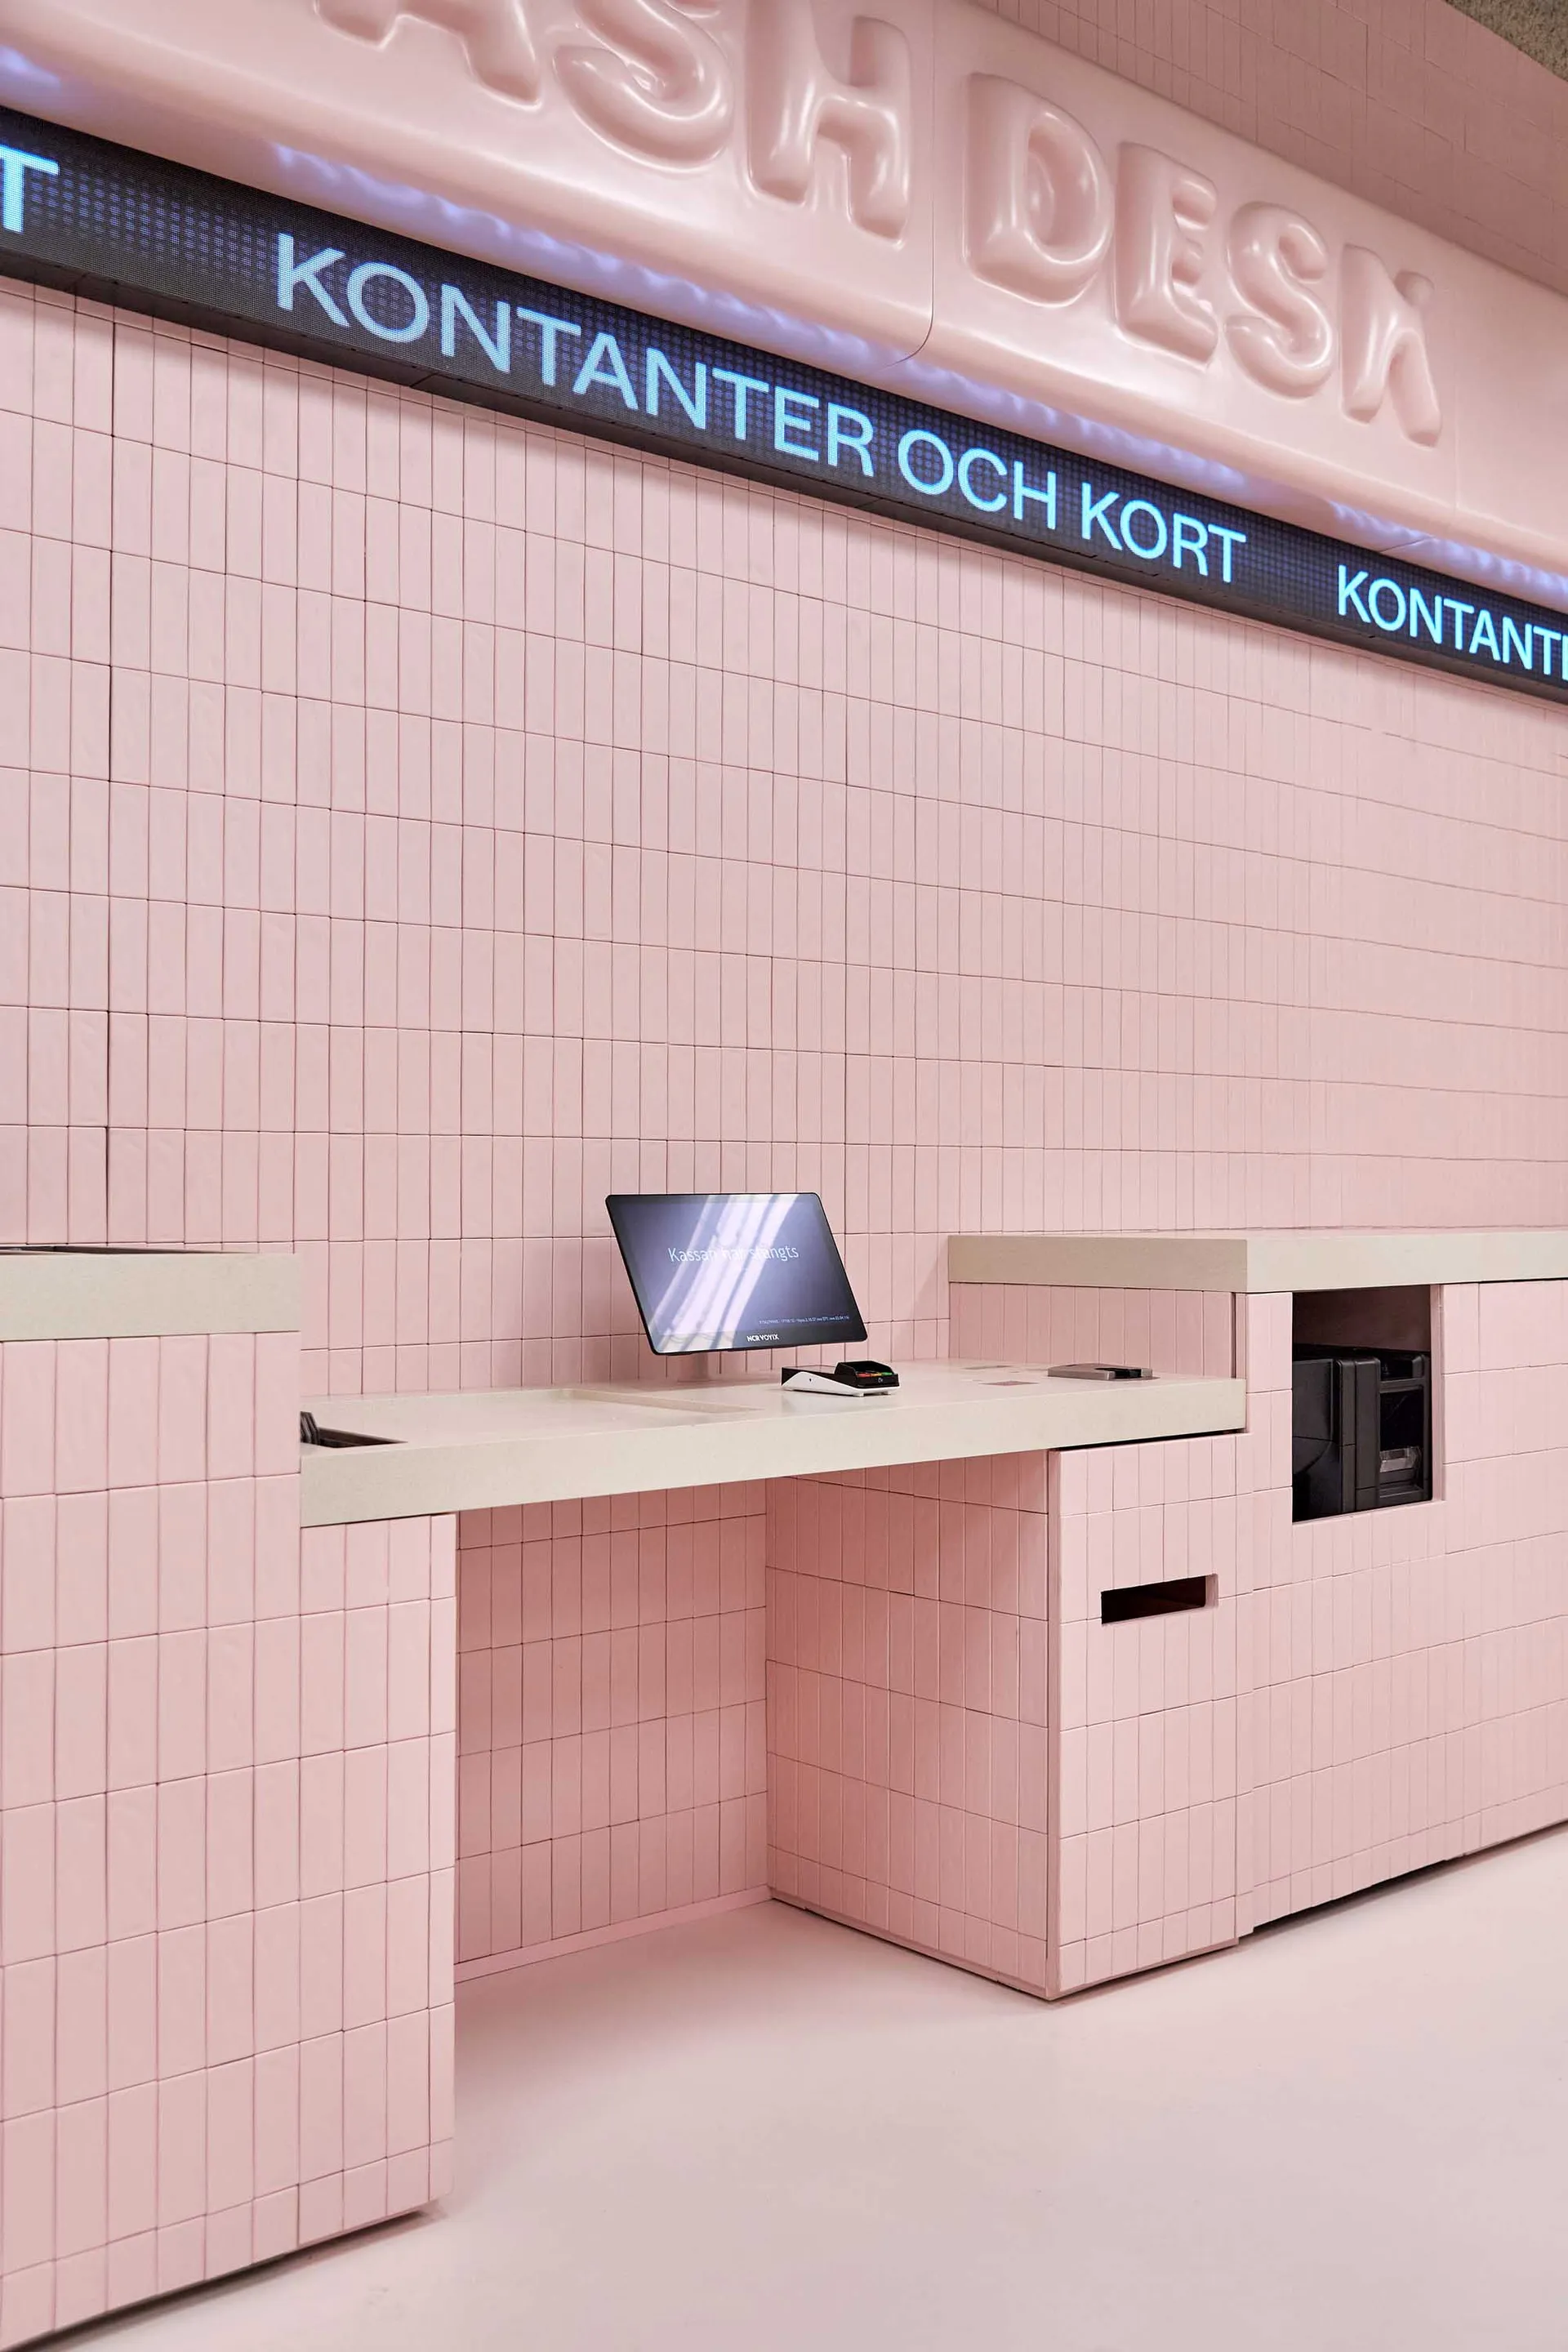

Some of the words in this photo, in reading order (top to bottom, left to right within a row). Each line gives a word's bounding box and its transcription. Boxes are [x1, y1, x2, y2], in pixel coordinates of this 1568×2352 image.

[962, 71, 1444, 448] DESK
[277, 232, 874, 478] KONTANTER
[898, 429, 1056, 531] OCH
[1081, 482, 1247, 584] KORT
[1337, 564, 1568, 682] KONTANT
[668, 1247, 716, 1263] Kassan
